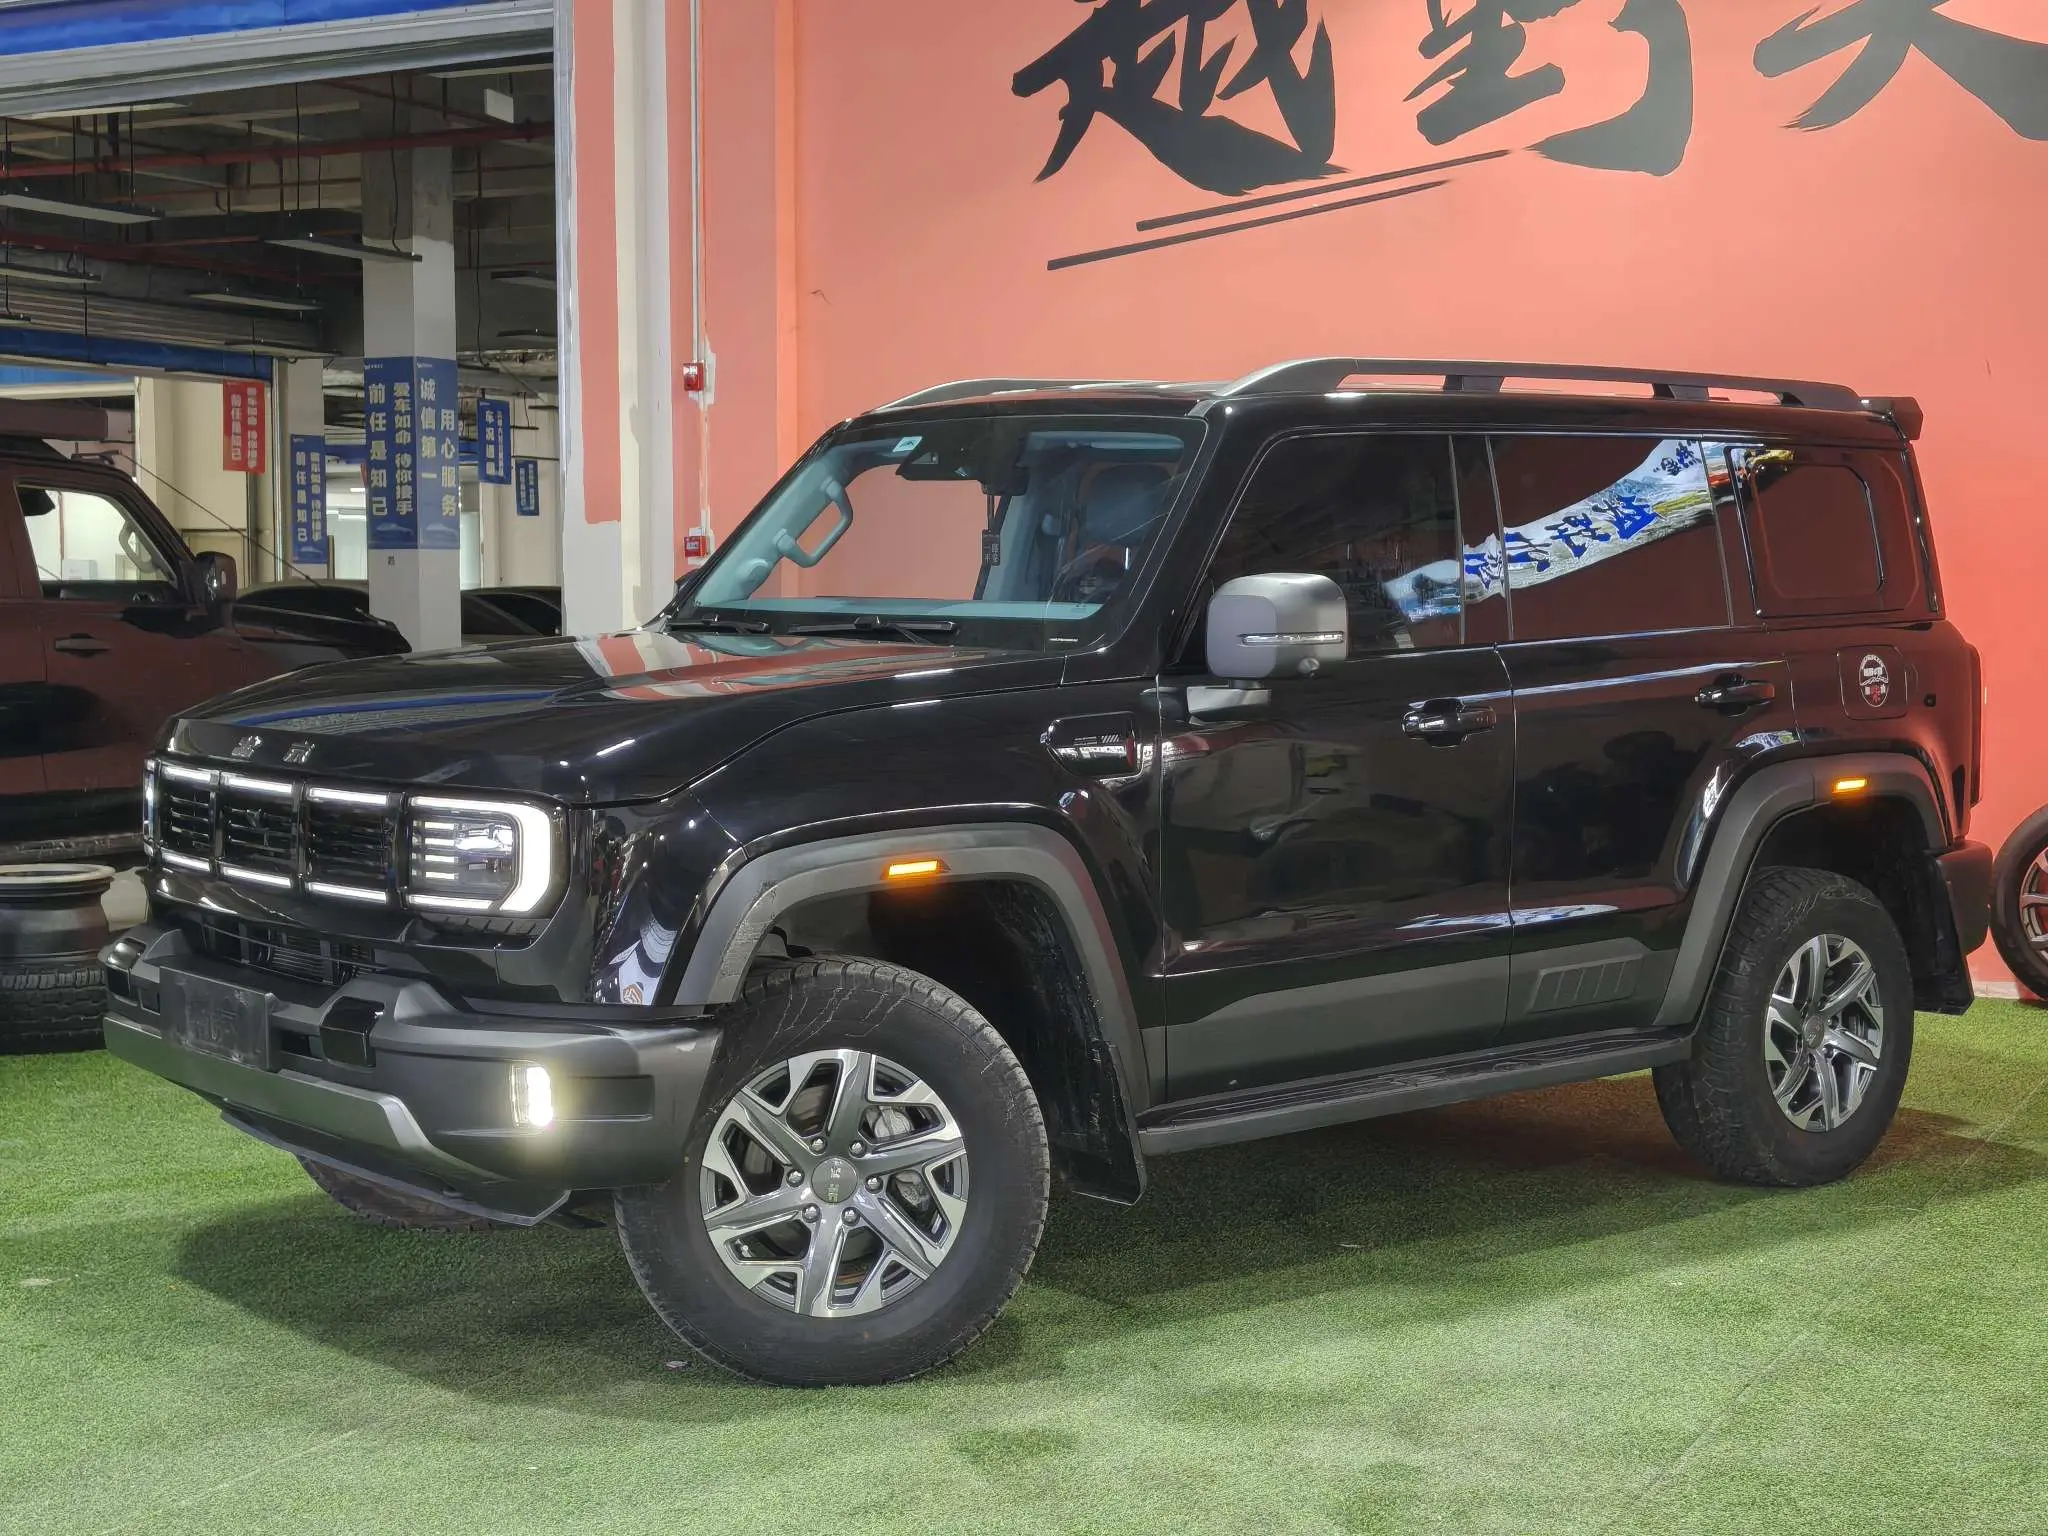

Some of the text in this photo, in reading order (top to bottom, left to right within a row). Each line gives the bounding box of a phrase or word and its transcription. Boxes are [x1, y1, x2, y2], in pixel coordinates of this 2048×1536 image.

[368, 382, 388, 517] 前任是知己
[419, 377, 438, 480] 诚信第一
[440, 408, 457, 517] 用心服务
